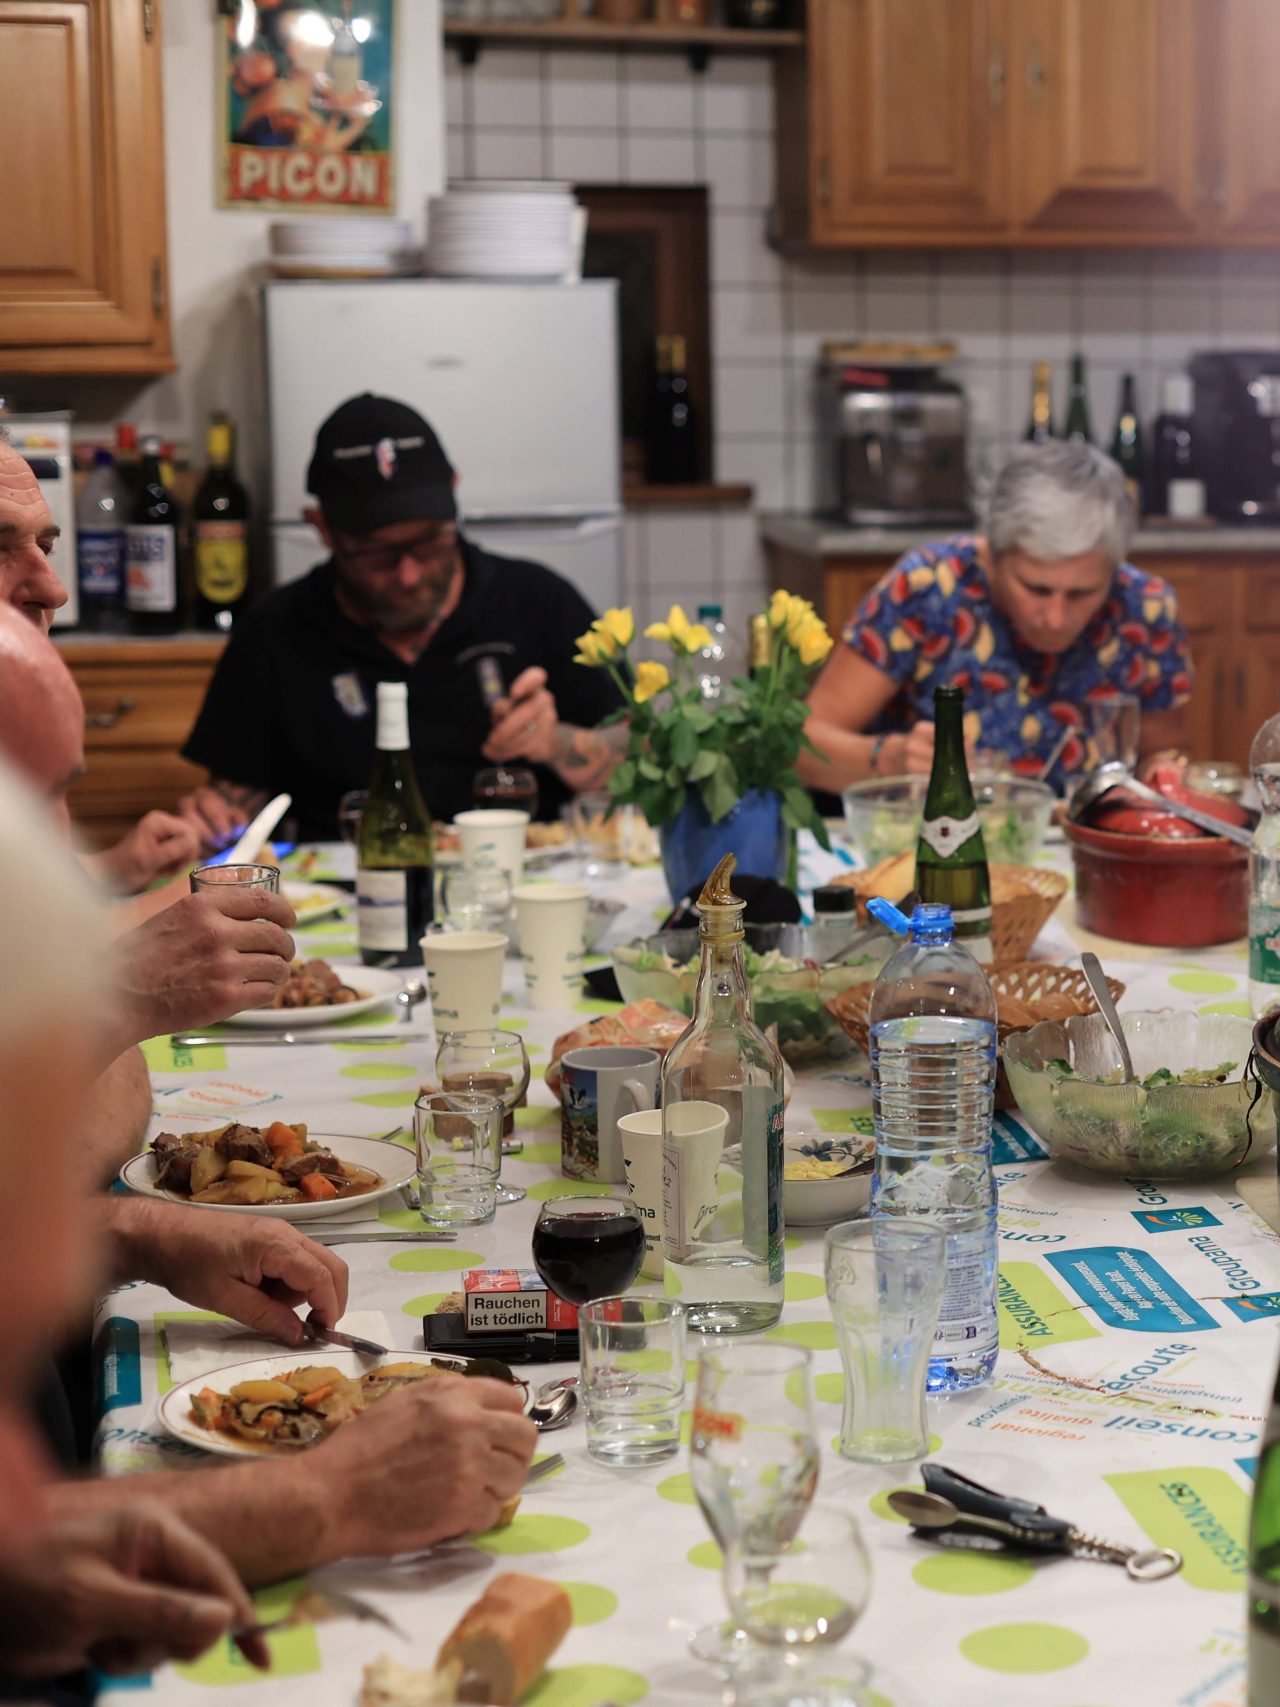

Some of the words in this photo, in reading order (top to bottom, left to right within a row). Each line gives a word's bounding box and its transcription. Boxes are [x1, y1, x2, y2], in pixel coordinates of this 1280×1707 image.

[239, 151, 379, 201] PICON
[1187, 1235, 1262, 1291] Groupama
[474, 1297, 541, 1311] Rauchen
[470, 1313, 489, 1327] ist
[493, 1312, 544, 1326] tödlich
[1100, 1342, 1198, 1391] écoute
[1018, 1407, 1094, 1426] qualité
[989, 1421, 1087, 1442] régional
[1102, 1415, 1259, 1445] conseil
